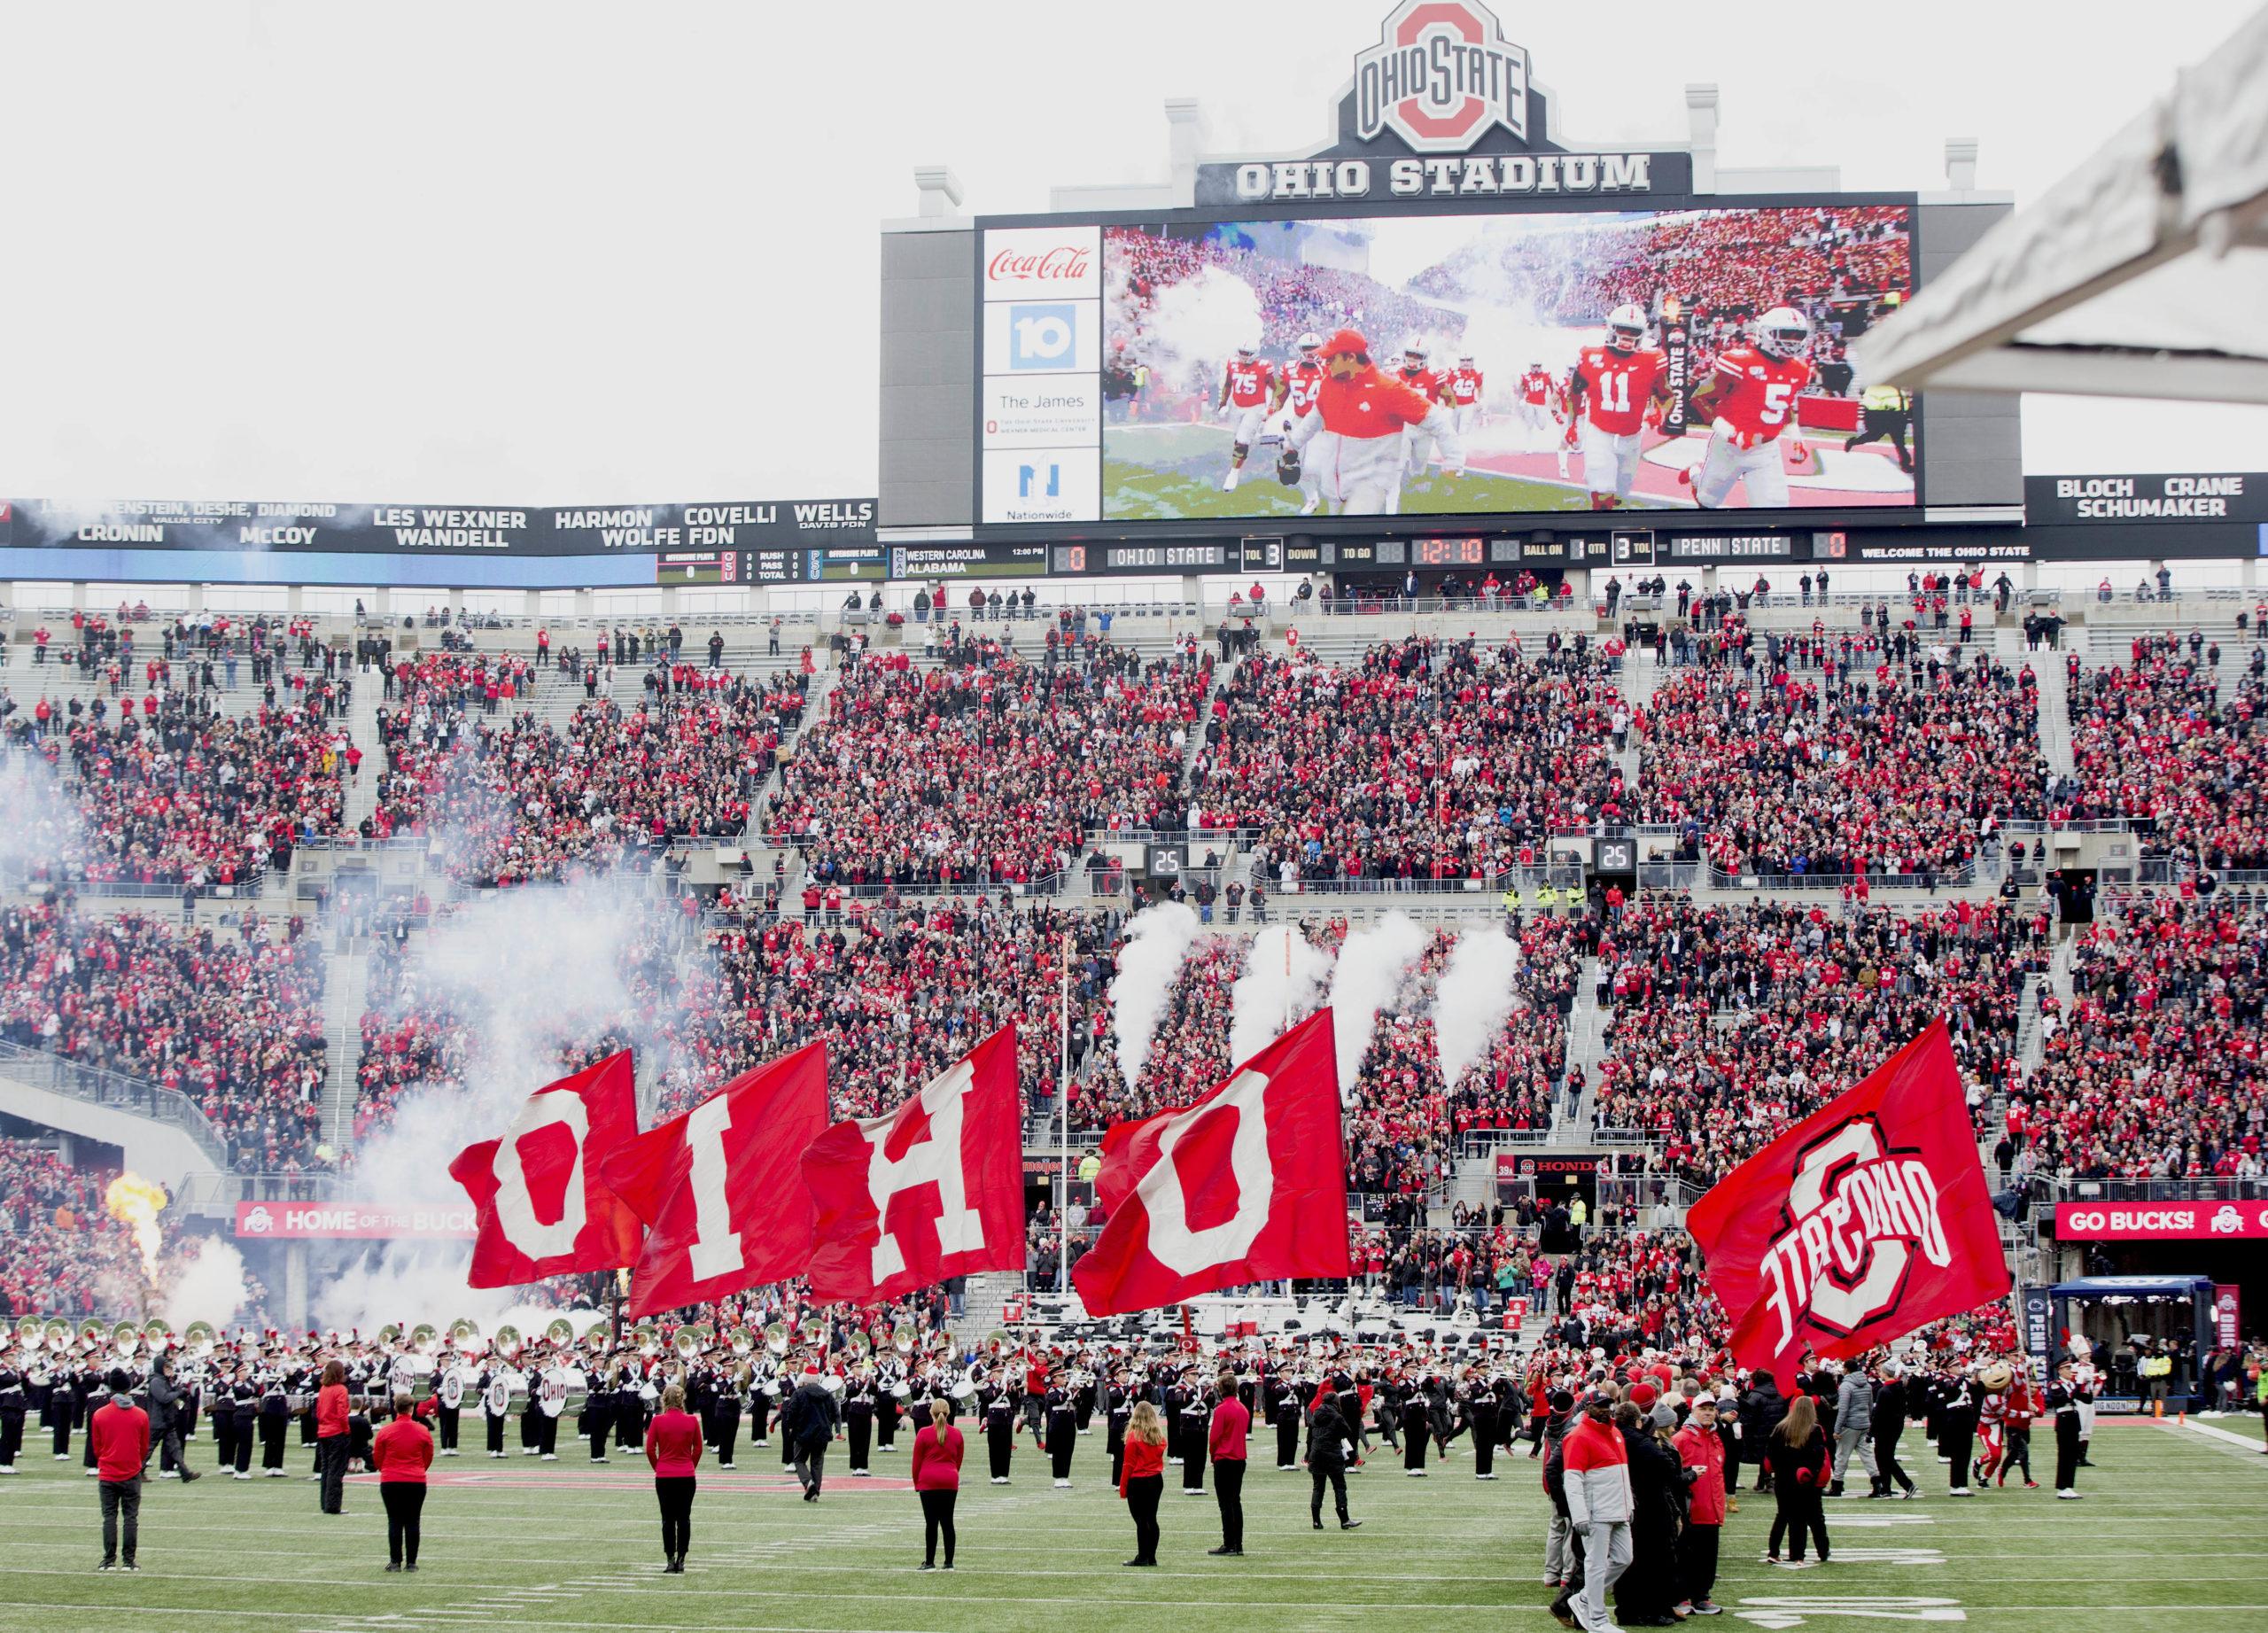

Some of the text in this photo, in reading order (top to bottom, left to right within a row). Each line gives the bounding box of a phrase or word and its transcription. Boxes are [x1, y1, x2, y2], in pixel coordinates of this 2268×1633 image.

[1236, 154, 1651, 200] OHIO STADIUM
[989, 246, 1092, 281] Coca-Cola
[1014, 316, 1072, 359] 10
[1669, 346, 1685, 386] STATE
[1231, 372, 1257, 395] 75
[1289, 379, 1322, 407] 54
[1599, 370, 1631, 413] 11
[1000, 394, 1084, 408] The James
[1759, 383, 1792, 424] 5
[2056, 478, 2134, 498] BLOCH
[2163, 477, 2243, 497] CRANE
[193, 502, 252, 518] DESHE,
[257, 503, 337, 518] DIAMOND
[684, 505, 777, 526] COVELLI
[794, 502, 873, 523] WELLS
[1006, 510, 1072, 521] Nationwide
[2077, 498, 2227, 518] SCHUMAKER
[373, 509, 527, 529] LES WEXNER
[555, 509, 653, 530] HARMON
[78, 524, 164, 542] CRONIN
[395, 528, 509, 548] WANDELL
[602, 527, 735, 548] WOLFE FDN
[906, 548, 986, 561] WESTERN CAROLINA
[1245, 549, 1262, 561] TOL
[1269, 544, 1280, 565] 3
[1287, 548, 1317, 560] DOWN
[1343, 548, 1371, 559] TO GO
[1423, 539, 1482, 564] 12:10
[1524, 544, 1563, 556] BALL ON
[1588, 543, 1606, 555] QTR
[1619, 537, 1630, 559] 3
[1634, 542, 1651, 554] TOL
[1681, 537, 1782, 556] PENN STATE
[1829, 533, 1846, 557] 0
[1861, 546, 2031, 558] WELCOME THE OHIO STATE
[759, 551, 785, 561] RUSH
[761, 561, 783, 571] PASS
[1070, 546, 1086, 571] 0
[1117, 547, 1215, 565] OHIO STATE
[686, 565, 695, 579] 0
[758, 571, 786, 579] TOTAL
[850, 562, 858, 575] 0
[905, 563, 967, 574] ALABAMA
[1155, 851, 1179, 873] 25
[1603, 845, 1627, 867] 25
[493, 1089, 589, 1262] O
[860, 1059, 986, 1287] H
[1137, 1069, 1275, 1278] O
[286, 1210, 356, 1231] HOME
[361, 1215, 380, 1228] OF
[383, 1215, 410, 1228] THE
[2069, 1212, 2106, 1231] GO
[2110, 1210, 2195, 1231] BUCKS!
[2029, 1314, 2047, 1351] PENN
[394, 1365, 414, 1389] STATE
[542, 1379, 566, 1402] OHIO
